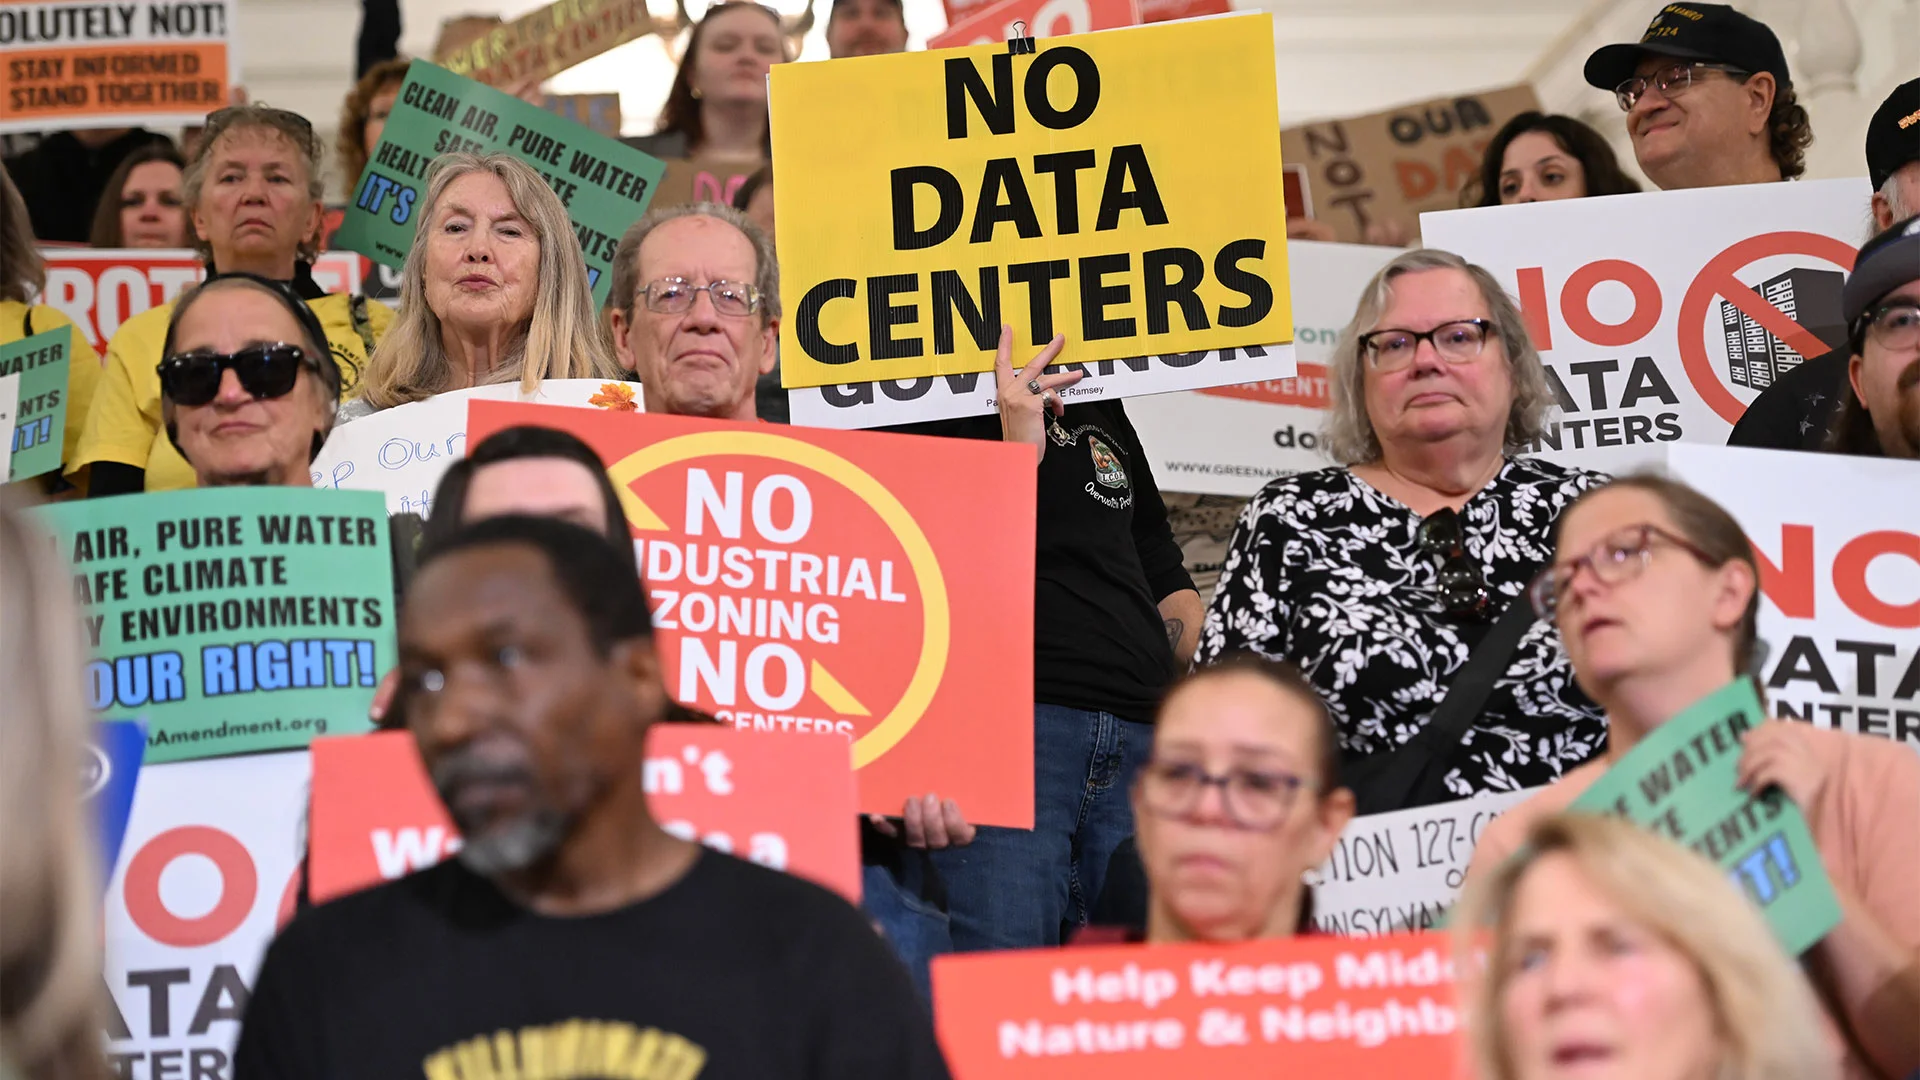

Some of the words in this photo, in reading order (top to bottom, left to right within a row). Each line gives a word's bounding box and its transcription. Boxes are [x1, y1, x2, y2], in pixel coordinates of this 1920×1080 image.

[150, 4, 226, 36] NOT!
[9, 57, 65, 82] STAY
[73, 52, 201, 77] INFORMED
[943, 46, 1101, 140] NO
[10, 84, 88, 111] STAND
[97, 80, 220, 106] TOGETHER
[402, 81, 459, 122] CLEAN
[459, 105, 499, 143] AIR,
[507, 124, 567, 167] PURE
[568, 149, 649, 203] WATER
[356, 171, 418, 226] IT'S
[889, 143, 1169, 252] DATA
[795, 239, 1274, 365] CENTERS
[1069, 385, 1104, 397] Ramsey
[1503, 411, 1683, 455] NTERS
[685, 467, 814, 545] NO
[73, 526, 141, 564] AIR,
[156, 516, 243, 551] PURE
[258, 514, 378, 547] WATER
[143, 555, 288, 597] CLIMATE
[121, 597, 383, 643] ENVIRONMENTS
[650, 590, 840, 645] ZONING
[202, 638, 377, 697] RIGHT!
[678, 636, 806, 711] NO
[1410, 810, 1504, 870] 127-C
[123, 825, 259, 949] O
[1051, 963, 1178, 1007] Help
[1190, 957, 1322, 1000] Keep
[999, 1013, 1184, 1059] Nature
[1198, 1009, 1248, 1046] &
